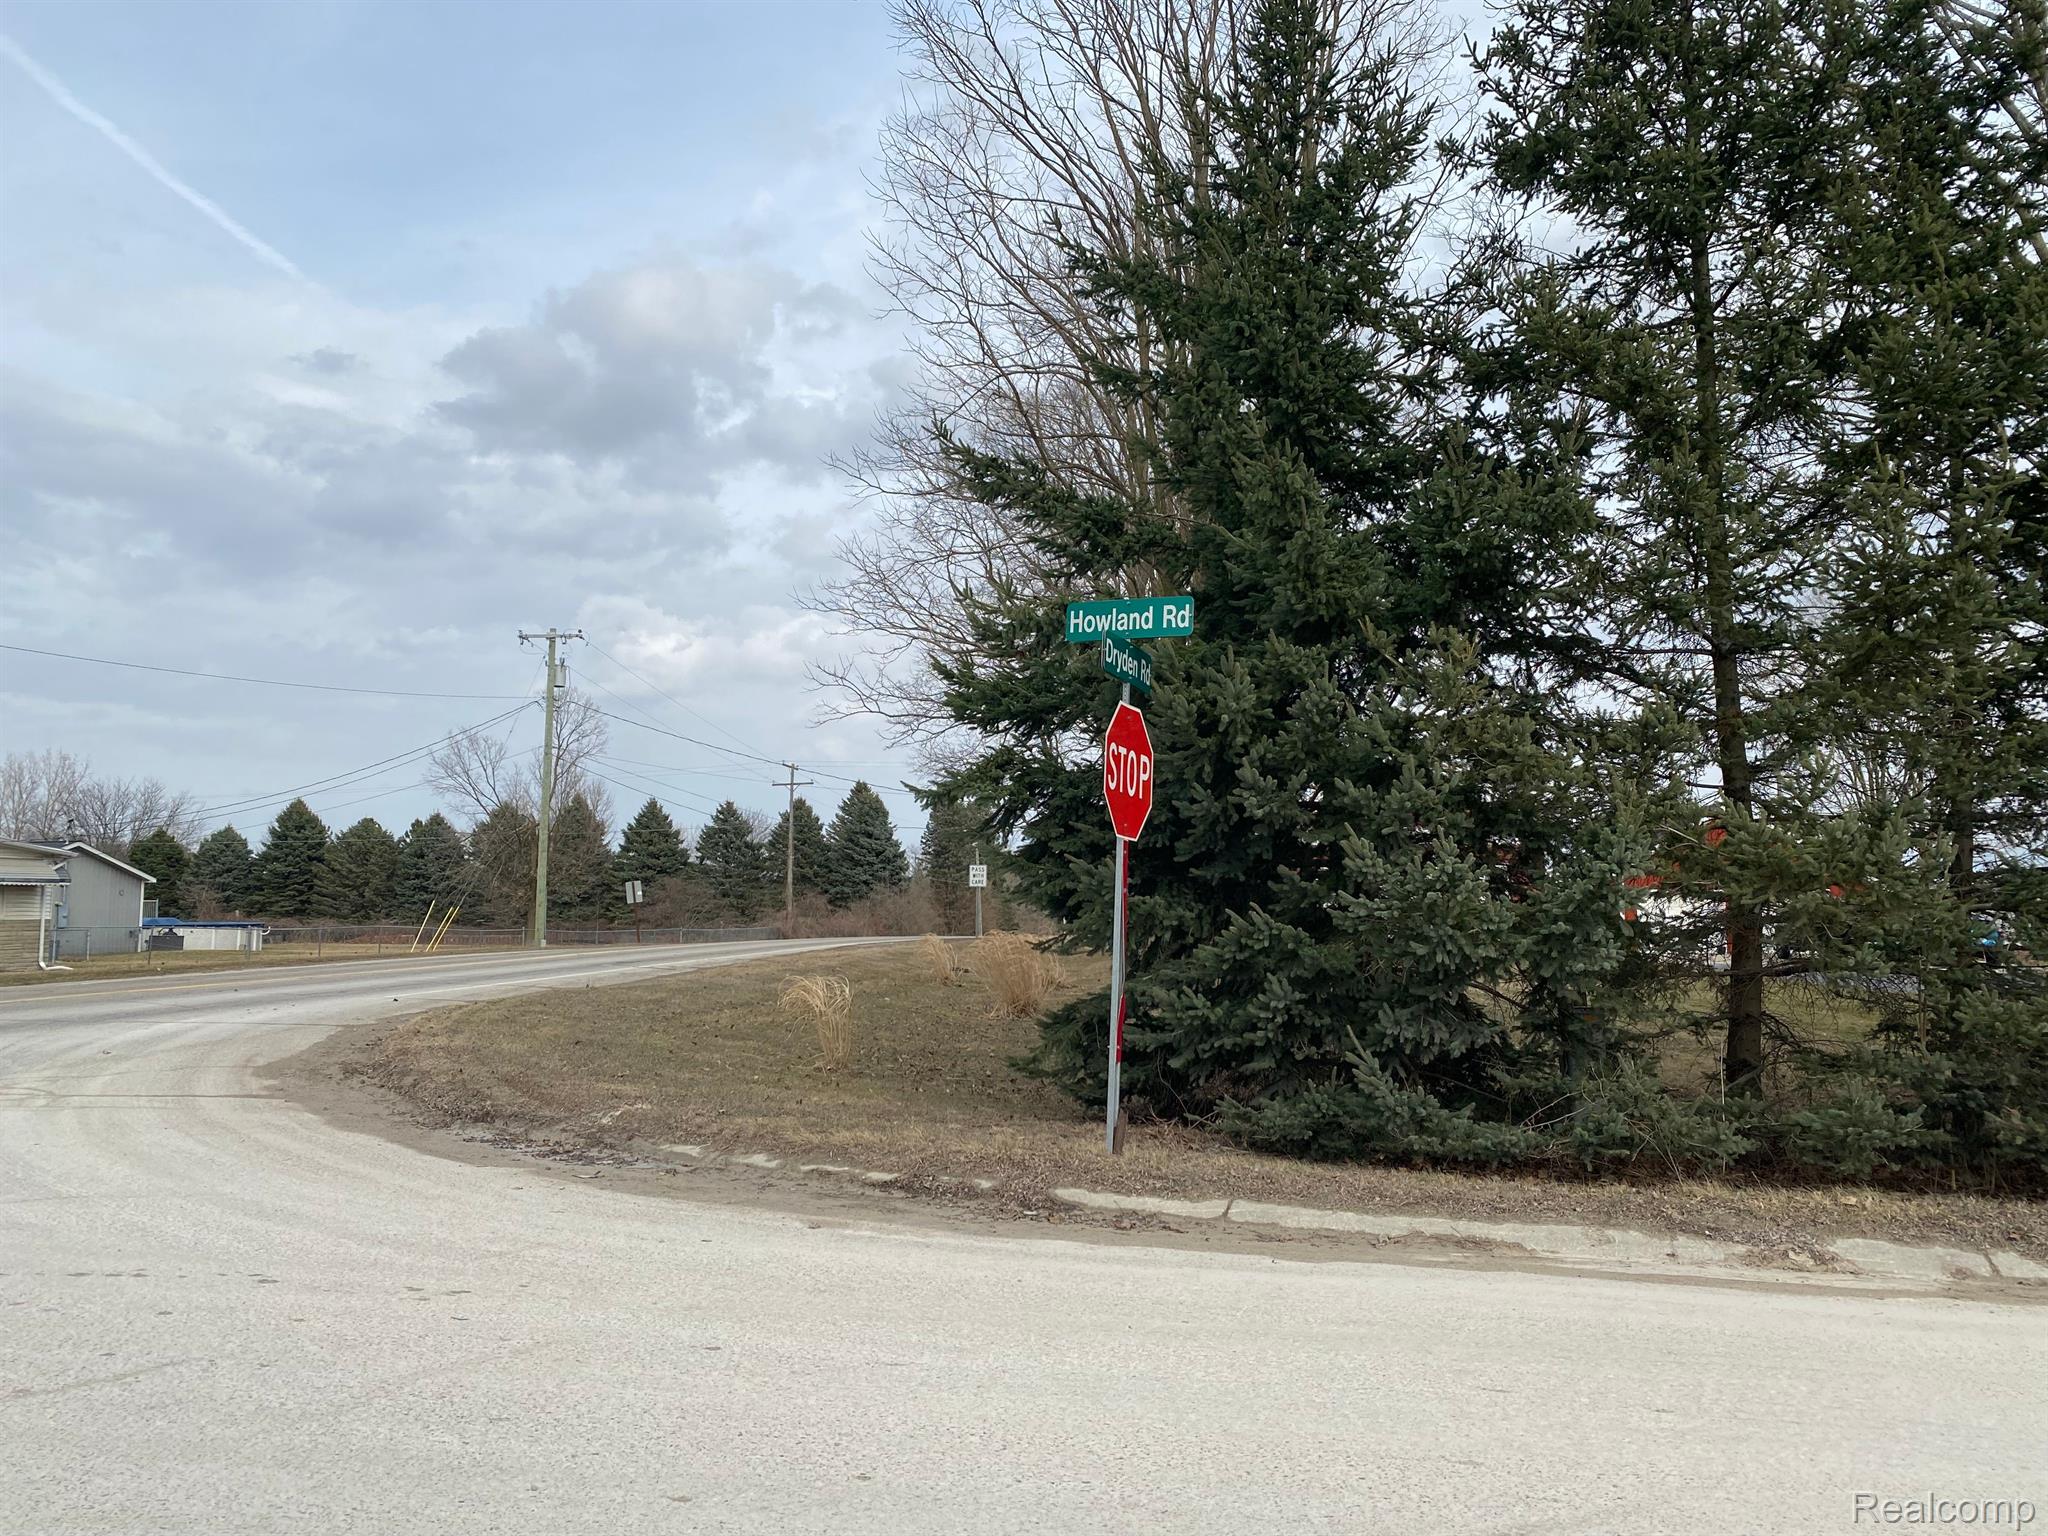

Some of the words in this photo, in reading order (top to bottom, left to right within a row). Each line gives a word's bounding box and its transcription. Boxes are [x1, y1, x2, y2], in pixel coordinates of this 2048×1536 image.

[1070, 605, 1154, 633] Howland
[1162, 604, 1190, 629] Rd
[1105, 637, 1138, 678] Dryden
[1140, 658, 1151, 686] Rd
[1107, 742, 1151, 800] STOP
